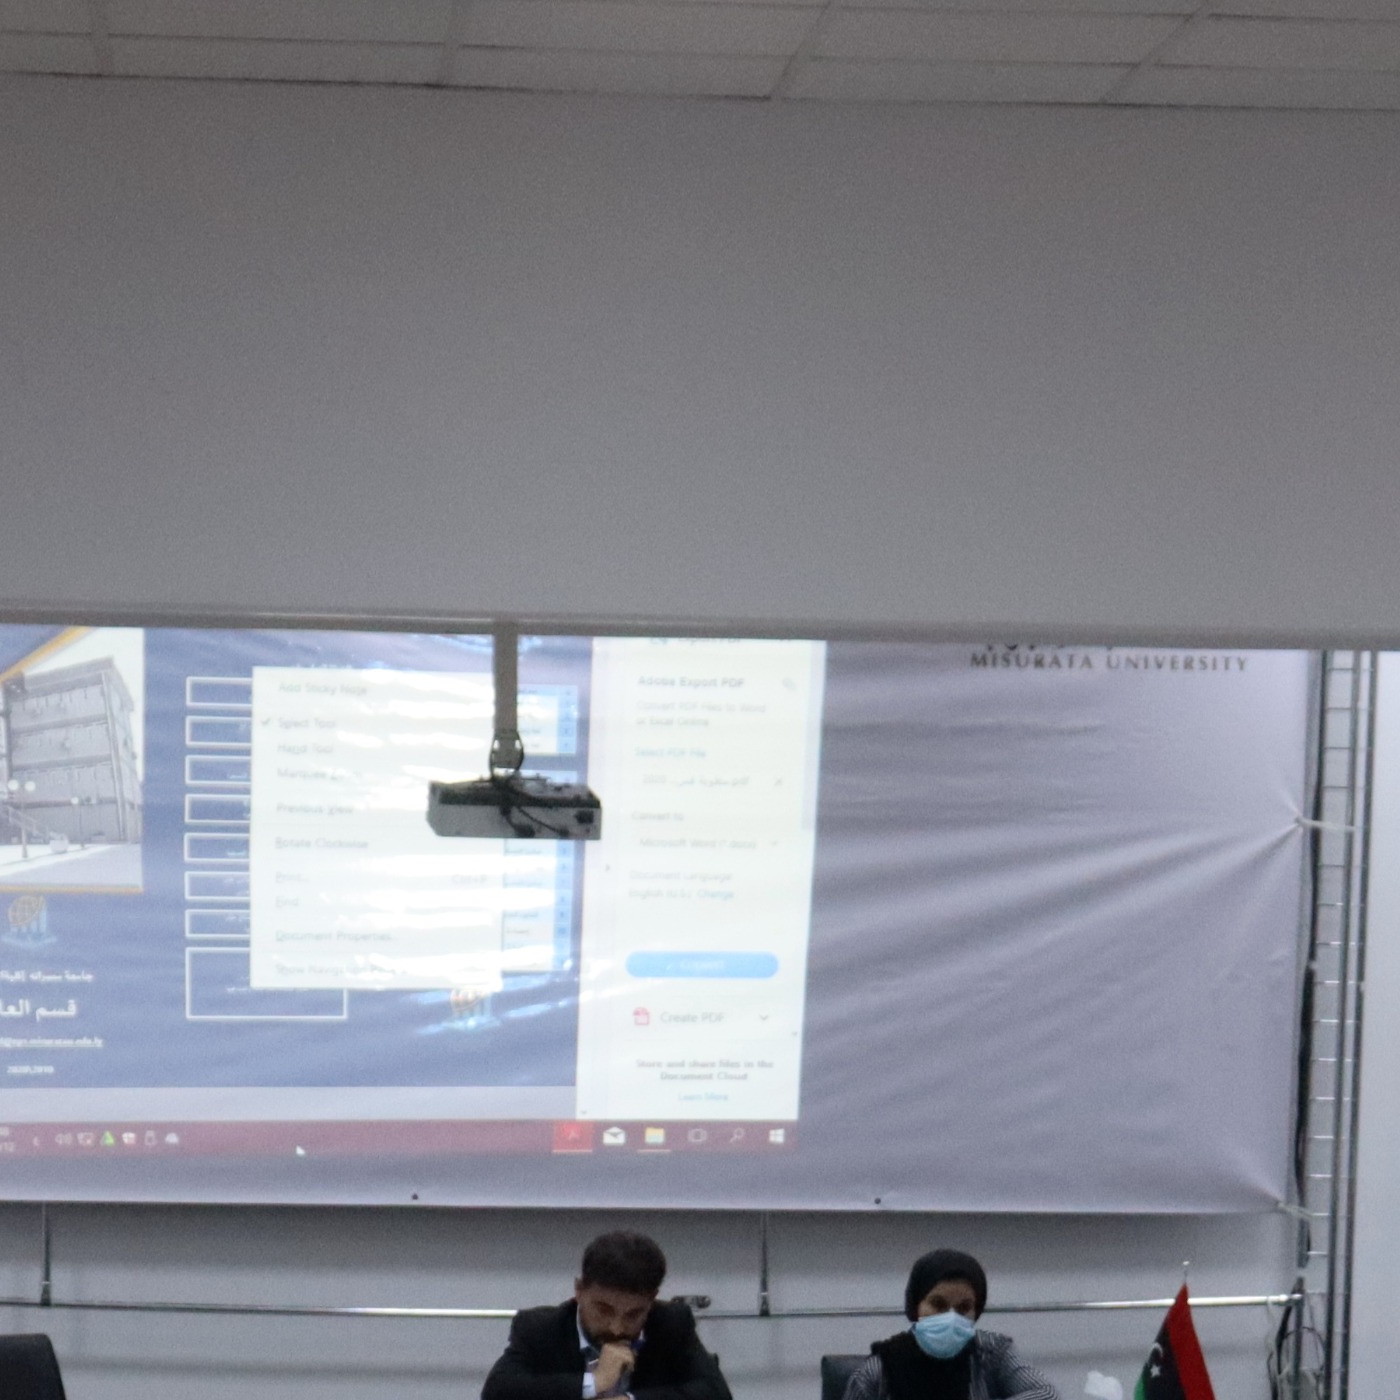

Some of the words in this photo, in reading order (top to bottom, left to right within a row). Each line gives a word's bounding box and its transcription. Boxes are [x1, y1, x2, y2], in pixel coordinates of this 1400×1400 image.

[970, 652, 1093, 670] MISURATA
[1107, 655, 1248, 672] UNIVERSITY
[638, 676, 675, 686] Adobe
[679, 676, 717, 689] Export
[721, 677, 745, 688] PDF
[639, 837, 686, 847] Microsoft
[629, 870, 681, 880] Document
[36, 999, 78, 1022] قسم
[660, 1011, 698, 1023] Create
[701, 1011, 725, 1023] PDF
[666, 1059, 685, 1068] and
[689, 1059, 716, 1068] share
[660, 1072, 713, 1081] Document
[717, 1072, 748, 1081] Cloud
